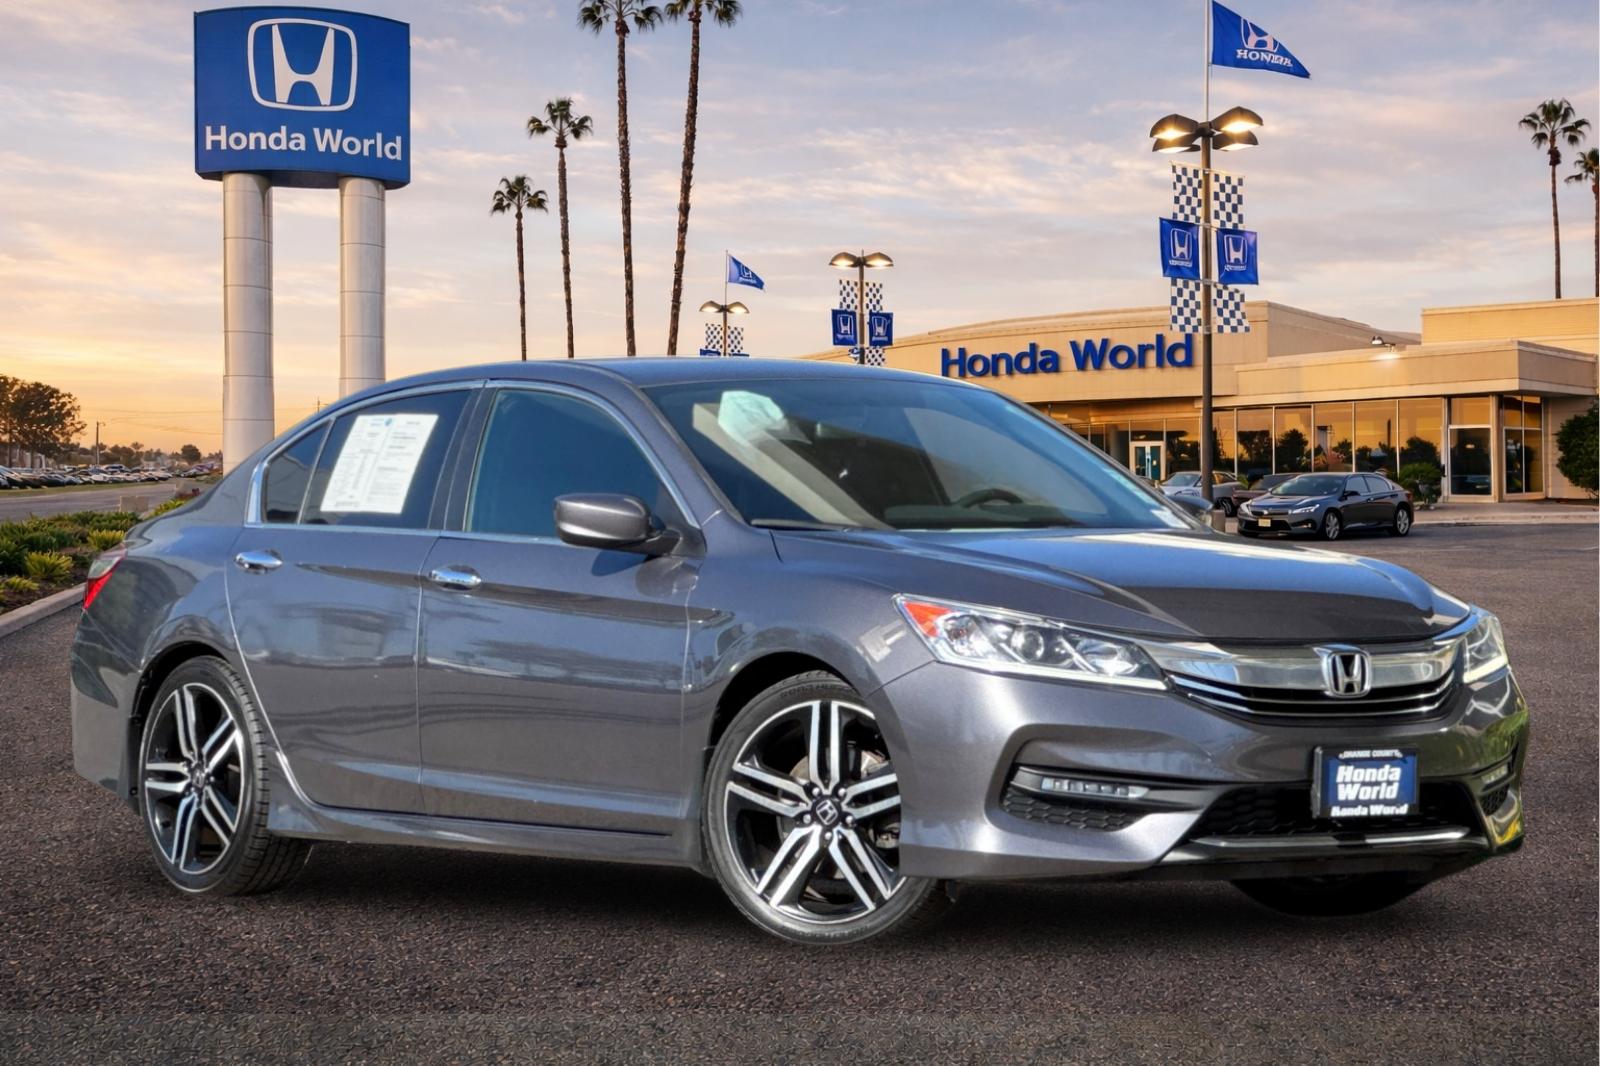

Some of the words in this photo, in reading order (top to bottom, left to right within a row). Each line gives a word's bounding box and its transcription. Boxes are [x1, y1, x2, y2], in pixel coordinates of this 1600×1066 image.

[205, 125, 306, 151] Honda
[313, 128, 402, 161] World
[941, 342, 1060, 378] Honda
[1069, 333, 1194, 371] World
[1336, 764, 1401, 783] Honda
[1337, 782, 1399, 801] World
[1331, 805, 1368, 817] Honda
